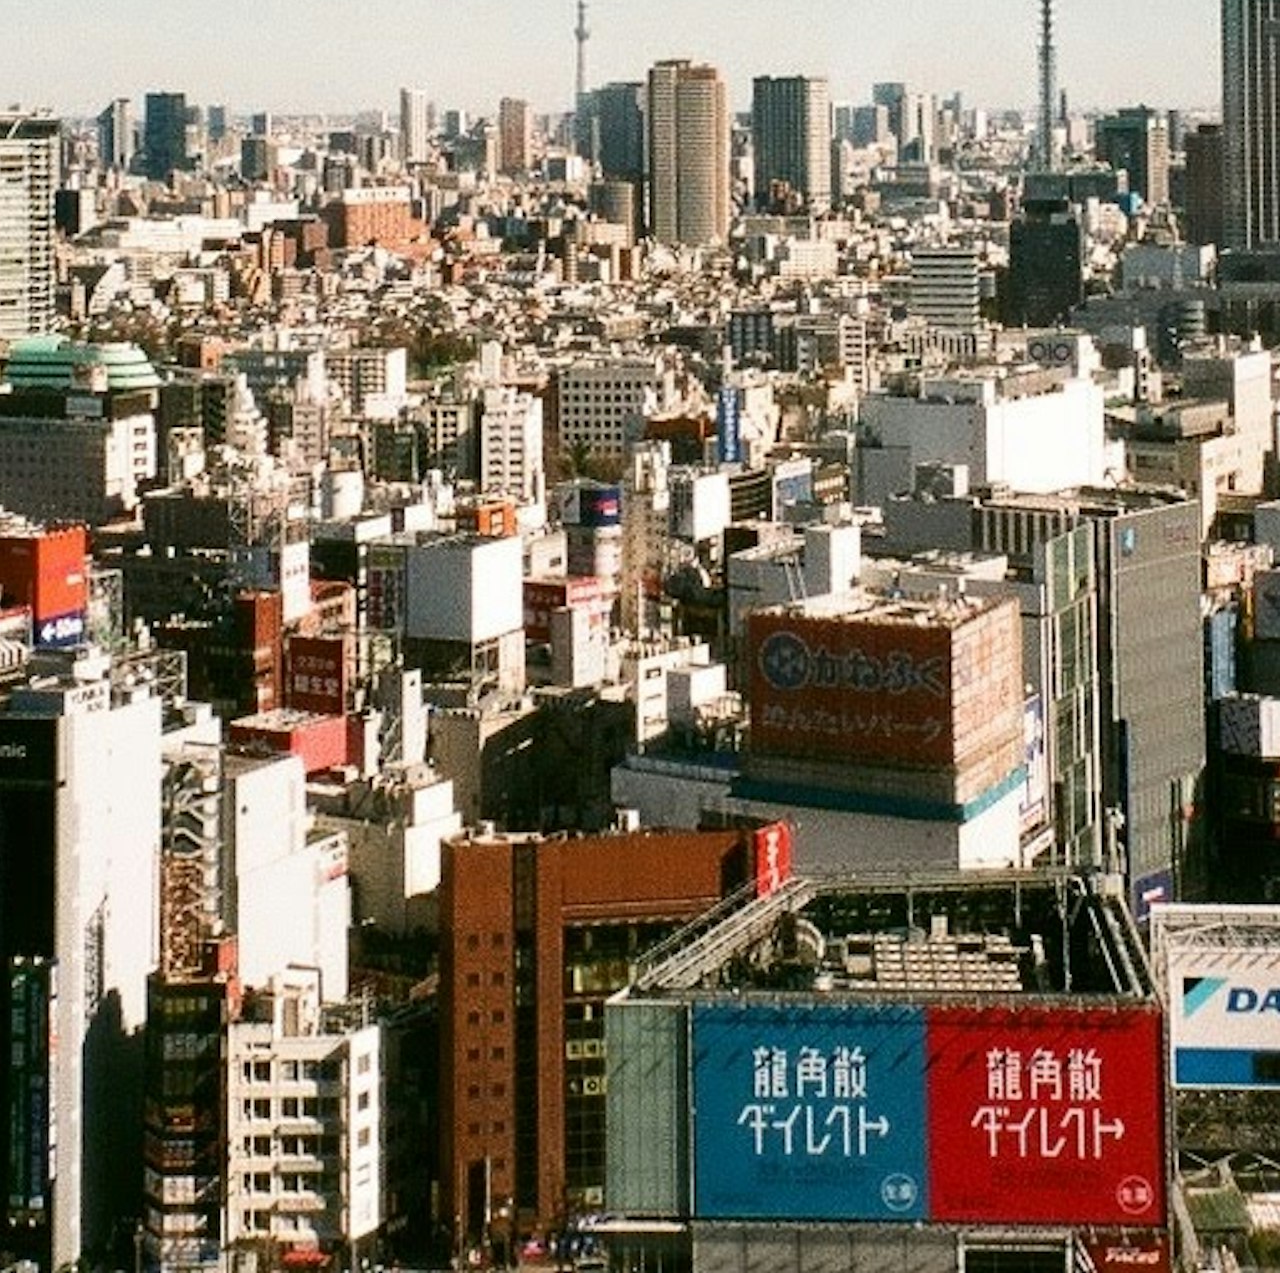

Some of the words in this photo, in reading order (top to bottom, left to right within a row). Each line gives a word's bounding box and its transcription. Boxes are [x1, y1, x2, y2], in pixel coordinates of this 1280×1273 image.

[753, 1045, 867, 1098] 龍角散
[986, 1046, 1102, 1100] 龍角散
[737, 1104, 890, 1155] ダイレクト
[970, 1107, 1125, 1159] ダイレクト
